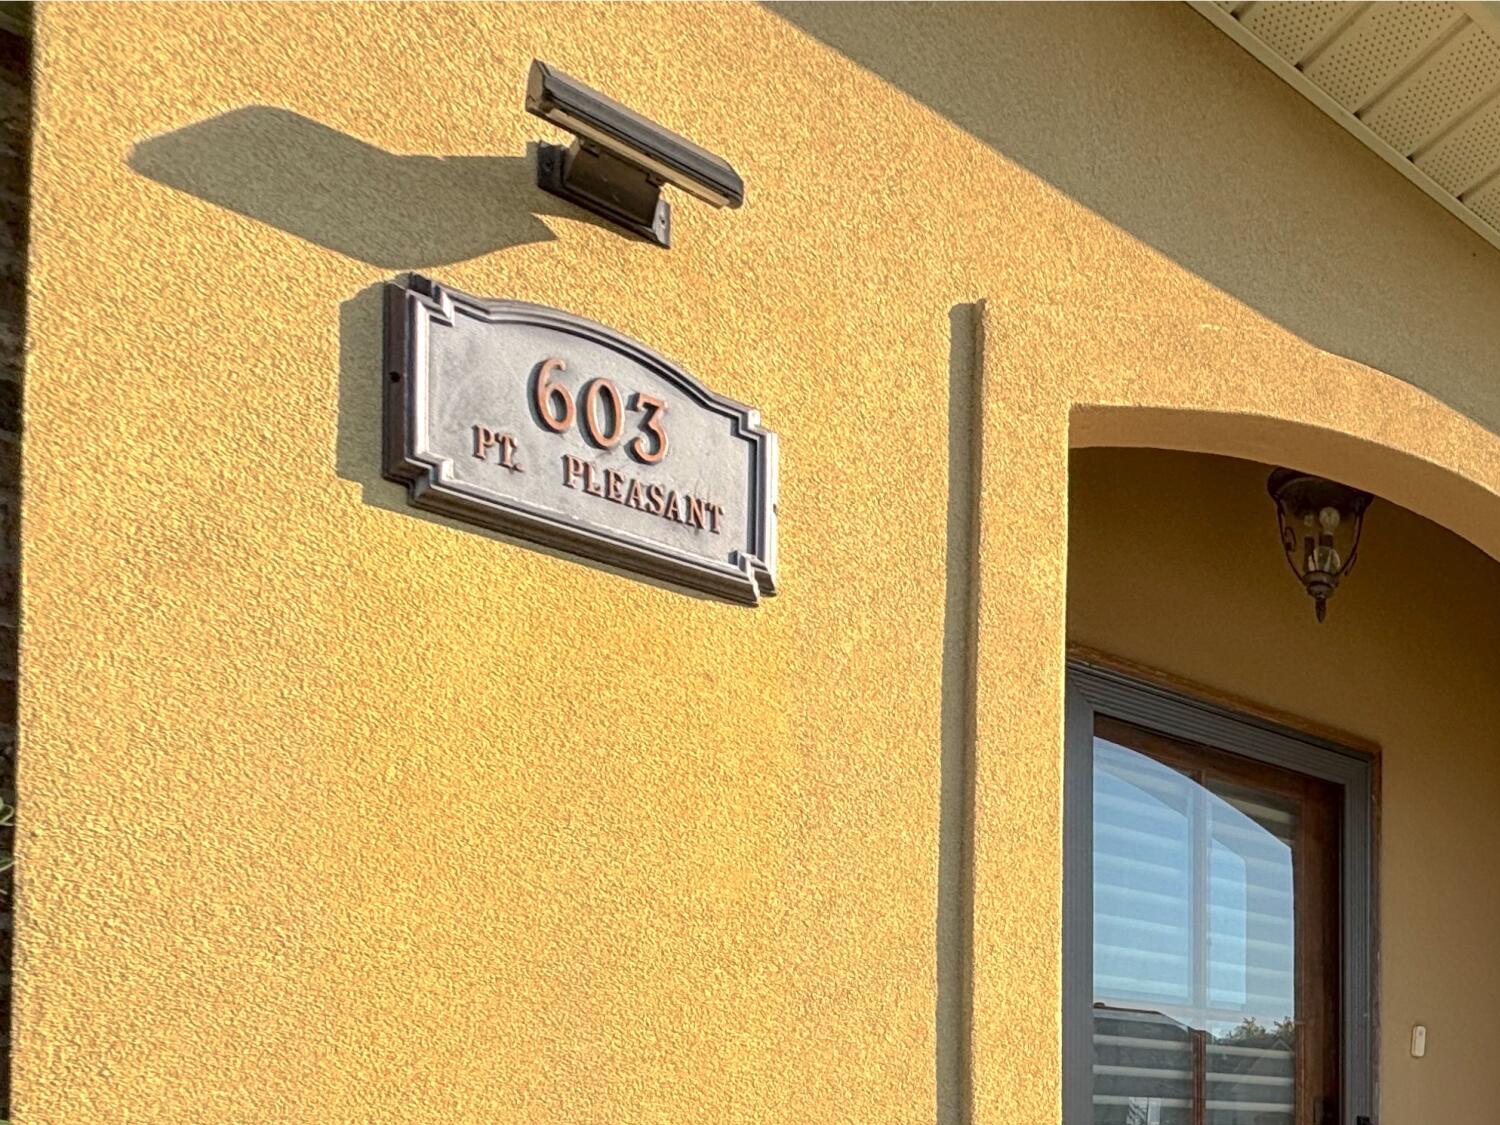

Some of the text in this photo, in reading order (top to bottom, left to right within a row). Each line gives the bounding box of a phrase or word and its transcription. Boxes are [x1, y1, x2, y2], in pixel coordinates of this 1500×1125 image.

[531, 358, 670, 465] 603
[473, 425, 724, 534] PT. PLEASANT
